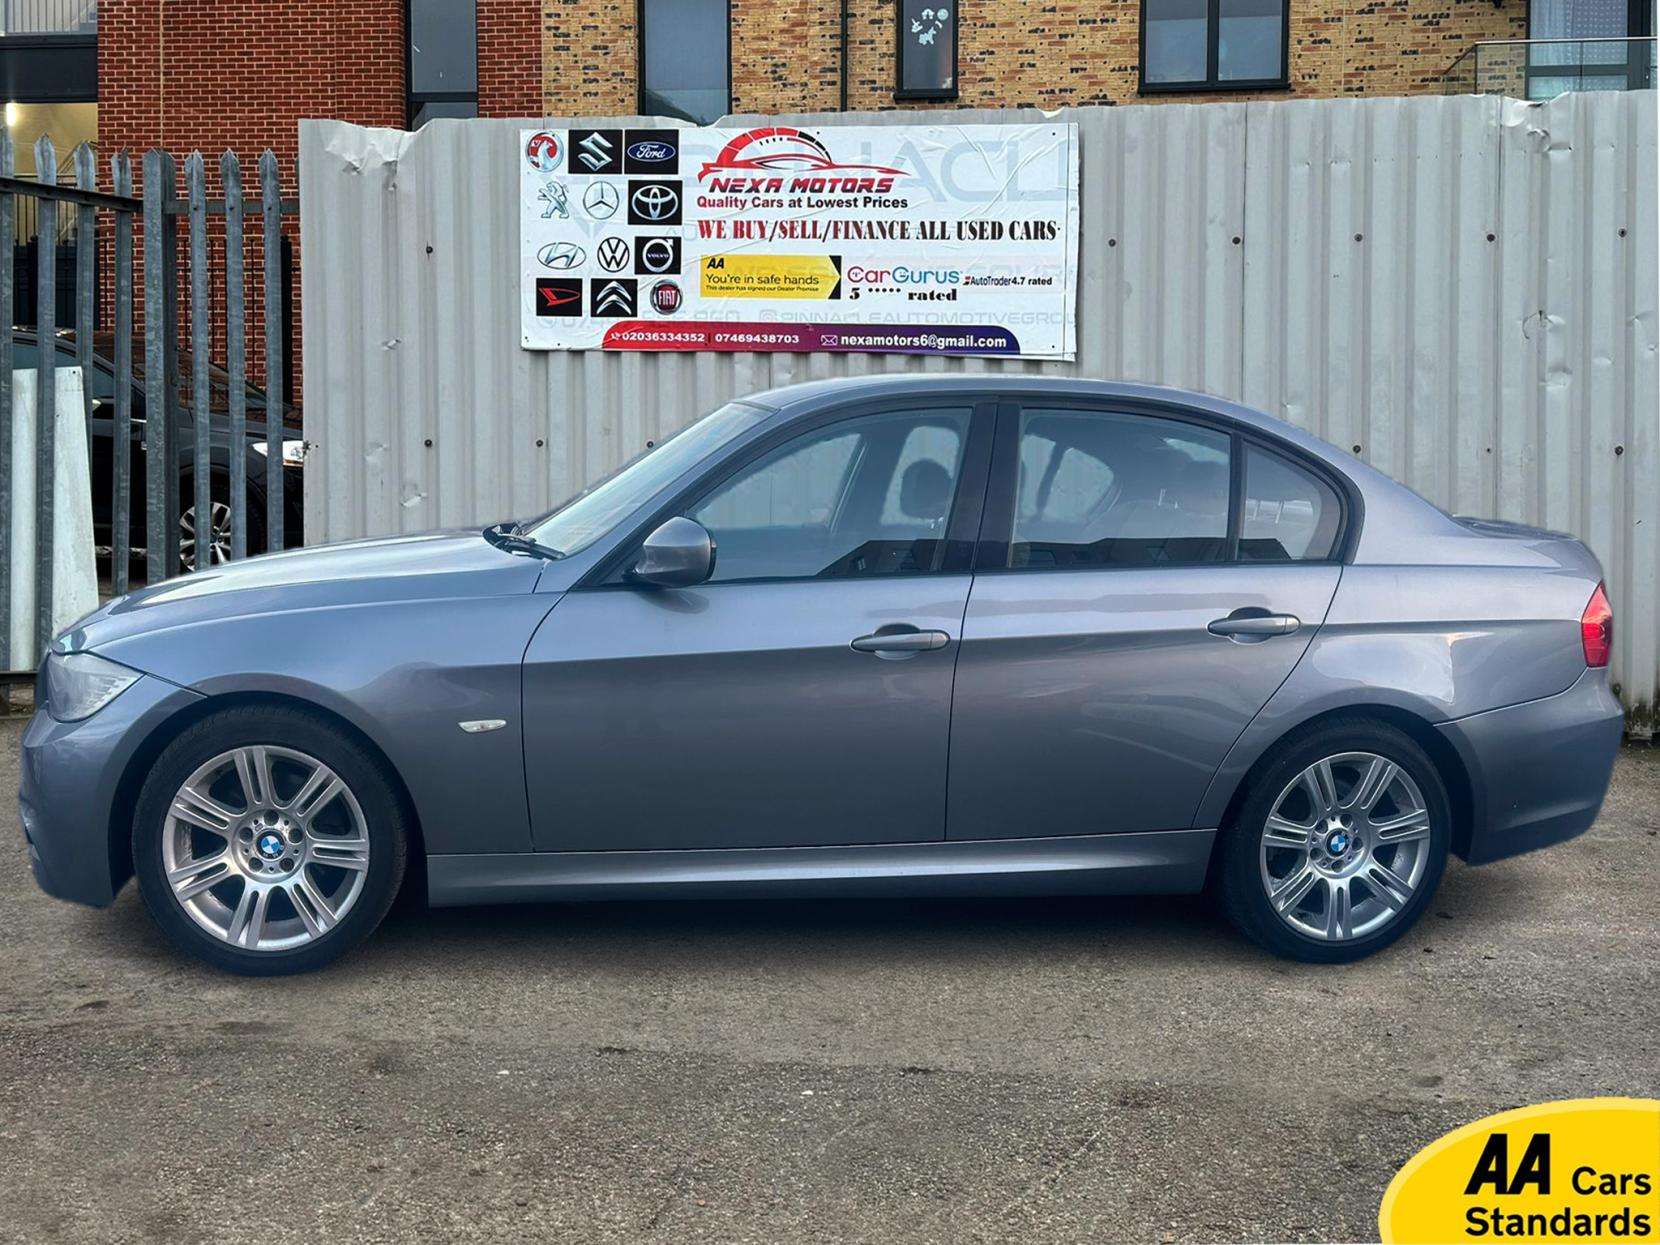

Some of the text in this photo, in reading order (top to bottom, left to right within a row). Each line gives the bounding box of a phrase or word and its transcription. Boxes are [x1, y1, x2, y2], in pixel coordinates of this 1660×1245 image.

[636, 144, 666, 159] Ford
[708, 178, 895, 193] NEXA MOTORS
[696, 196, 908, 211] Quality Cars at Lowest Prices
[697, 220, 727, 240] WE
[733, 220, 911, 243] BUY/SELL/FINANCE
[916, 221, 951, 240] ALL
[956, 221, 1004, 241] USED
[1009, 221, 1057, 241] CARS
[707, 257, 725, 269] AA
[705, 273, 820, 285] You're in safe hands
[847, 266, 960, 284] CarGurus
[1028, 276, 1053, 286] rated
[658, 290, 677, 306] FIAT
[849, 287, 957, 301] 5 rated
[622, 332, 800, 344] 02036334352 07469438703
[841, 334, 1007, 349] nexamotors6@gmail.com
